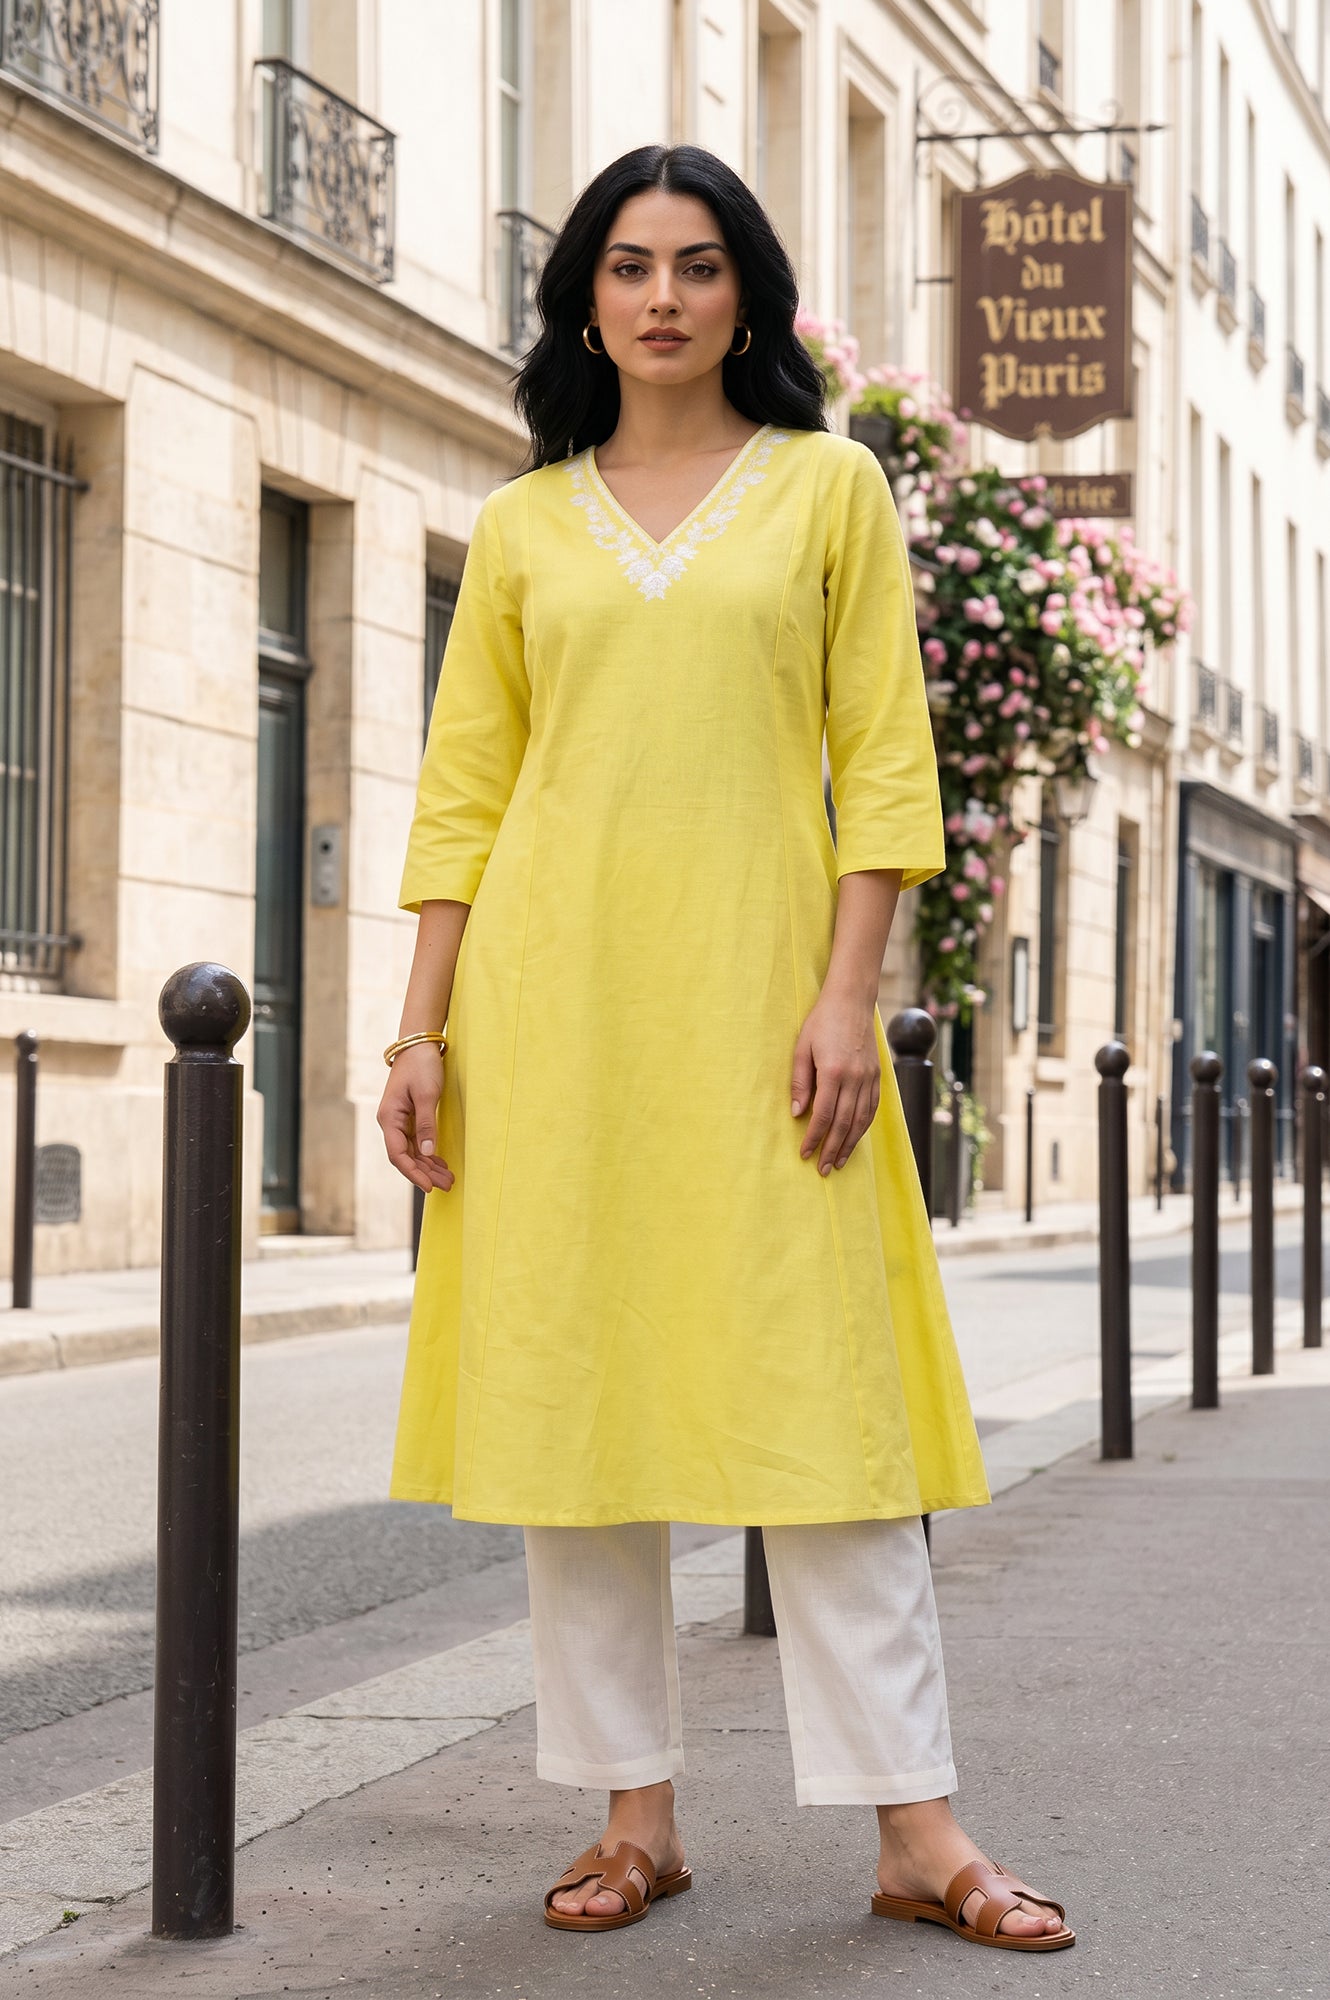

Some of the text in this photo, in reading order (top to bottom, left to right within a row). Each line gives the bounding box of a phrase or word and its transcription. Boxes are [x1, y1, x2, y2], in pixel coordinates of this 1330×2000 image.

[981, 196, 1106, 254] Hôtel
[1021, 254, 1064, 290] du
[976, 295, 1106, 342] Vieux
[979, 353, 1106, 410] Paris
